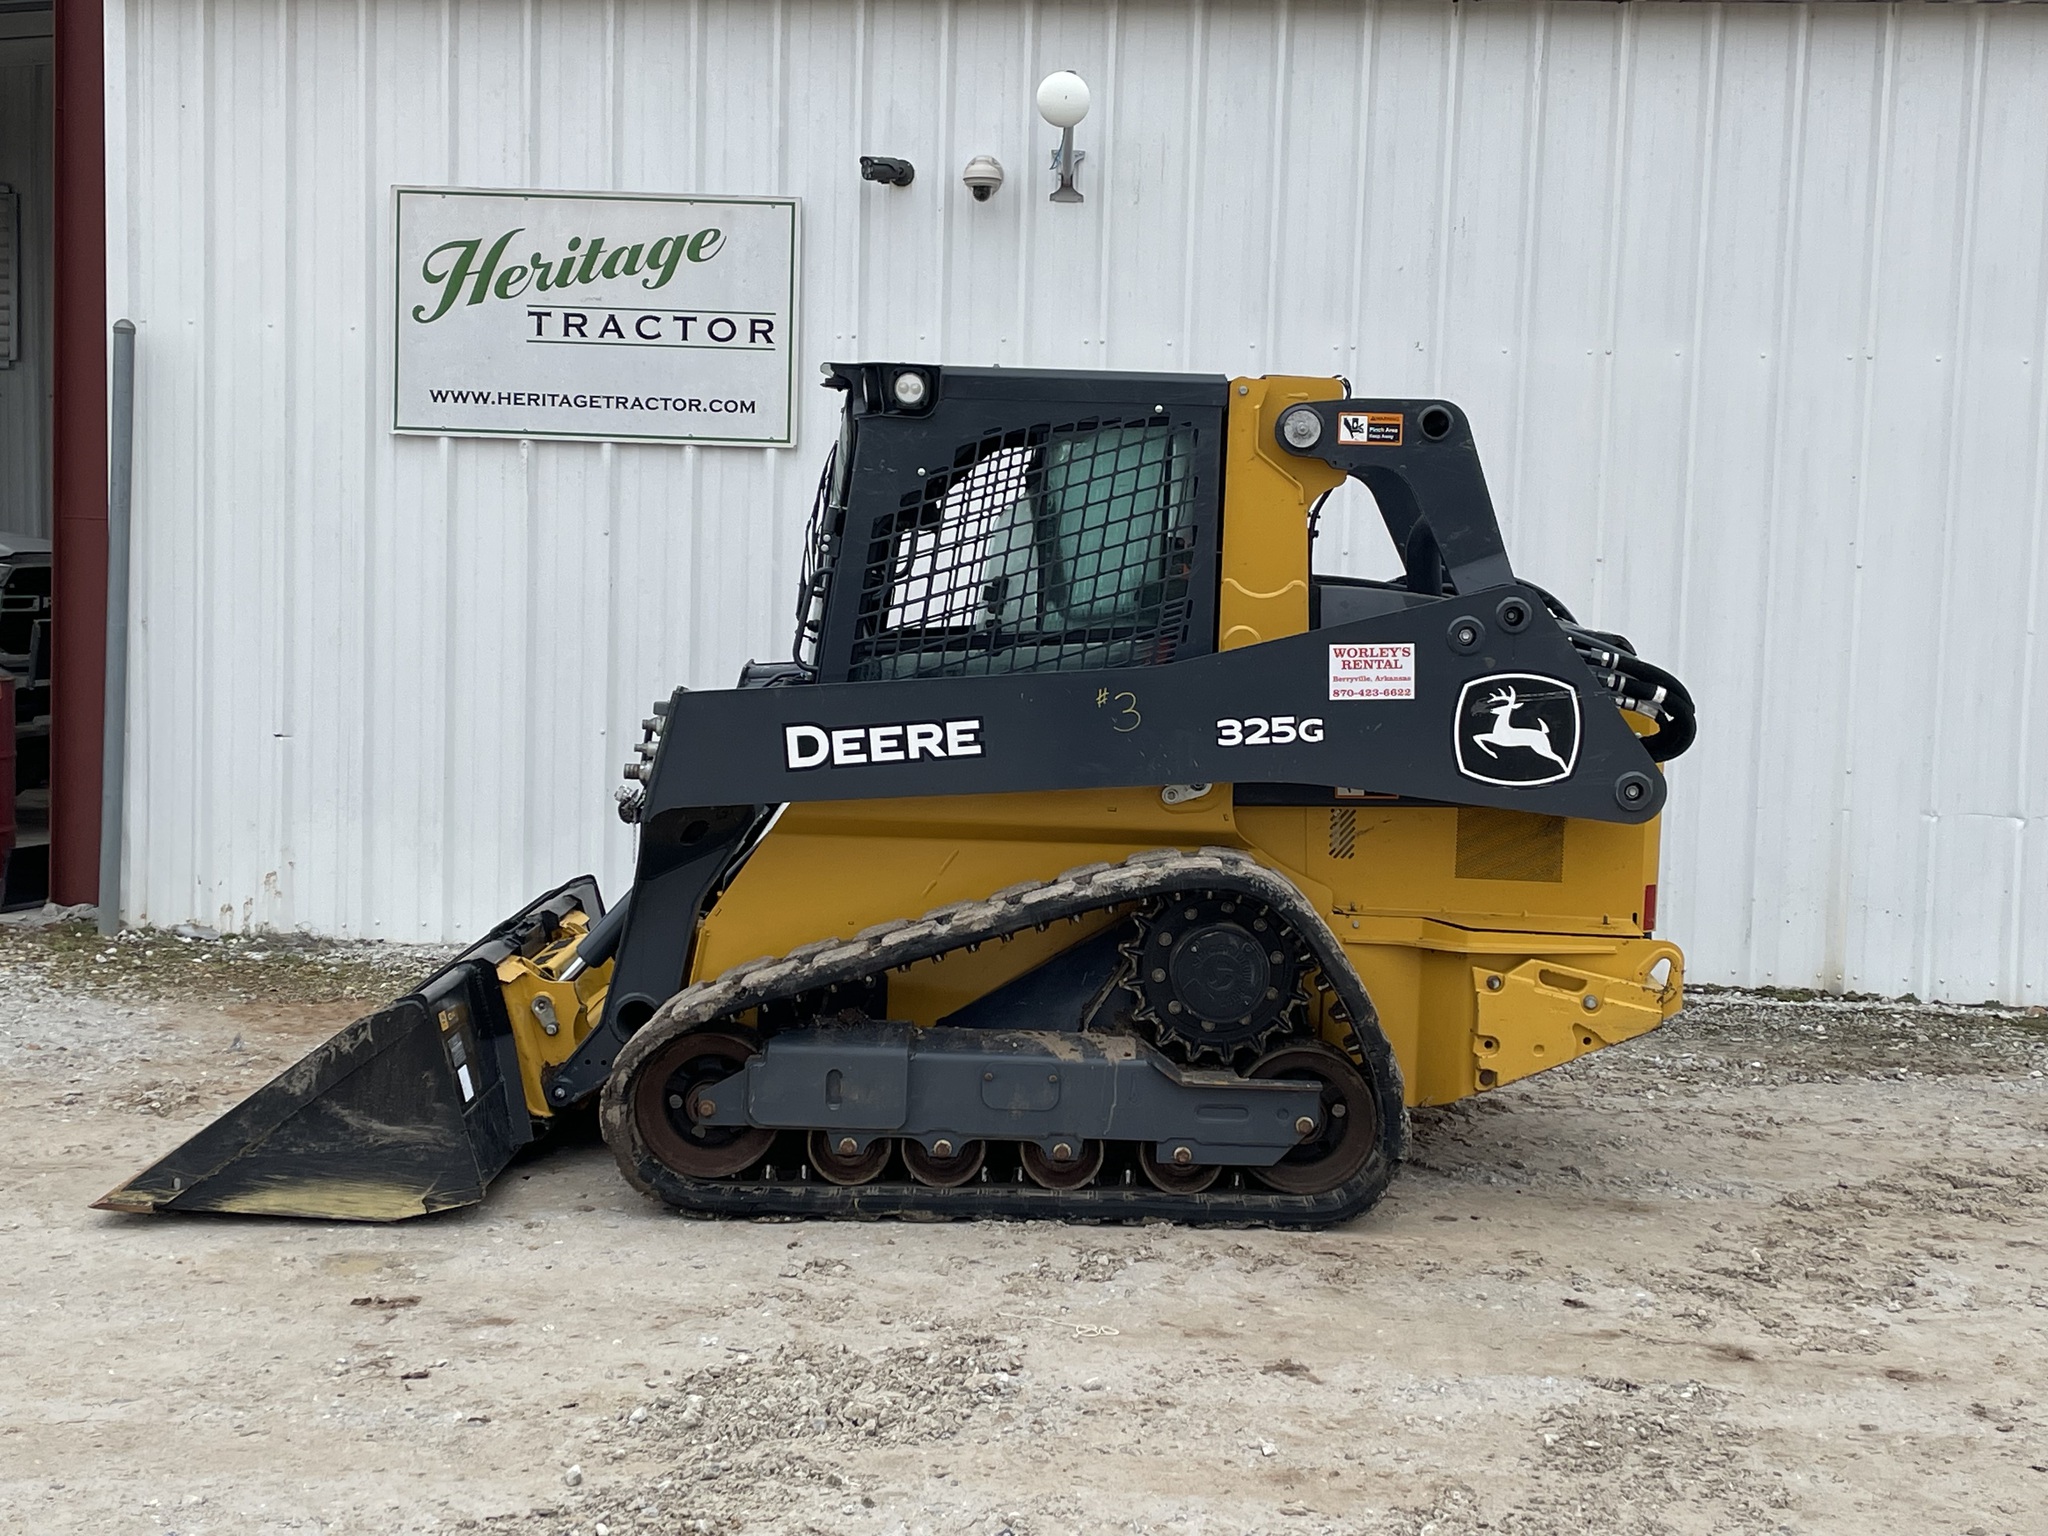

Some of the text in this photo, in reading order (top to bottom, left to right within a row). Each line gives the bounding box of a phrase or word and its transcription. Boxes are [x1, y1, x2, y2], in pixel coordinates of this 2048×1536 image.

[412, 227, 727, 323] Heritage
[527, 310, 775, 344] TRACTOR
[429, 389, 757, 414] WWW.HERITAGETRACTOR.COM
[1333, 647, 1411, 658] WORLEY'S
[1341, 659, 1403, 670] RENTAL
[1333, 689, 1411, 697] 870-423-6622
[785, 719, 982, 769] DEERE
[1216, 716, 1324, 746] 325G
